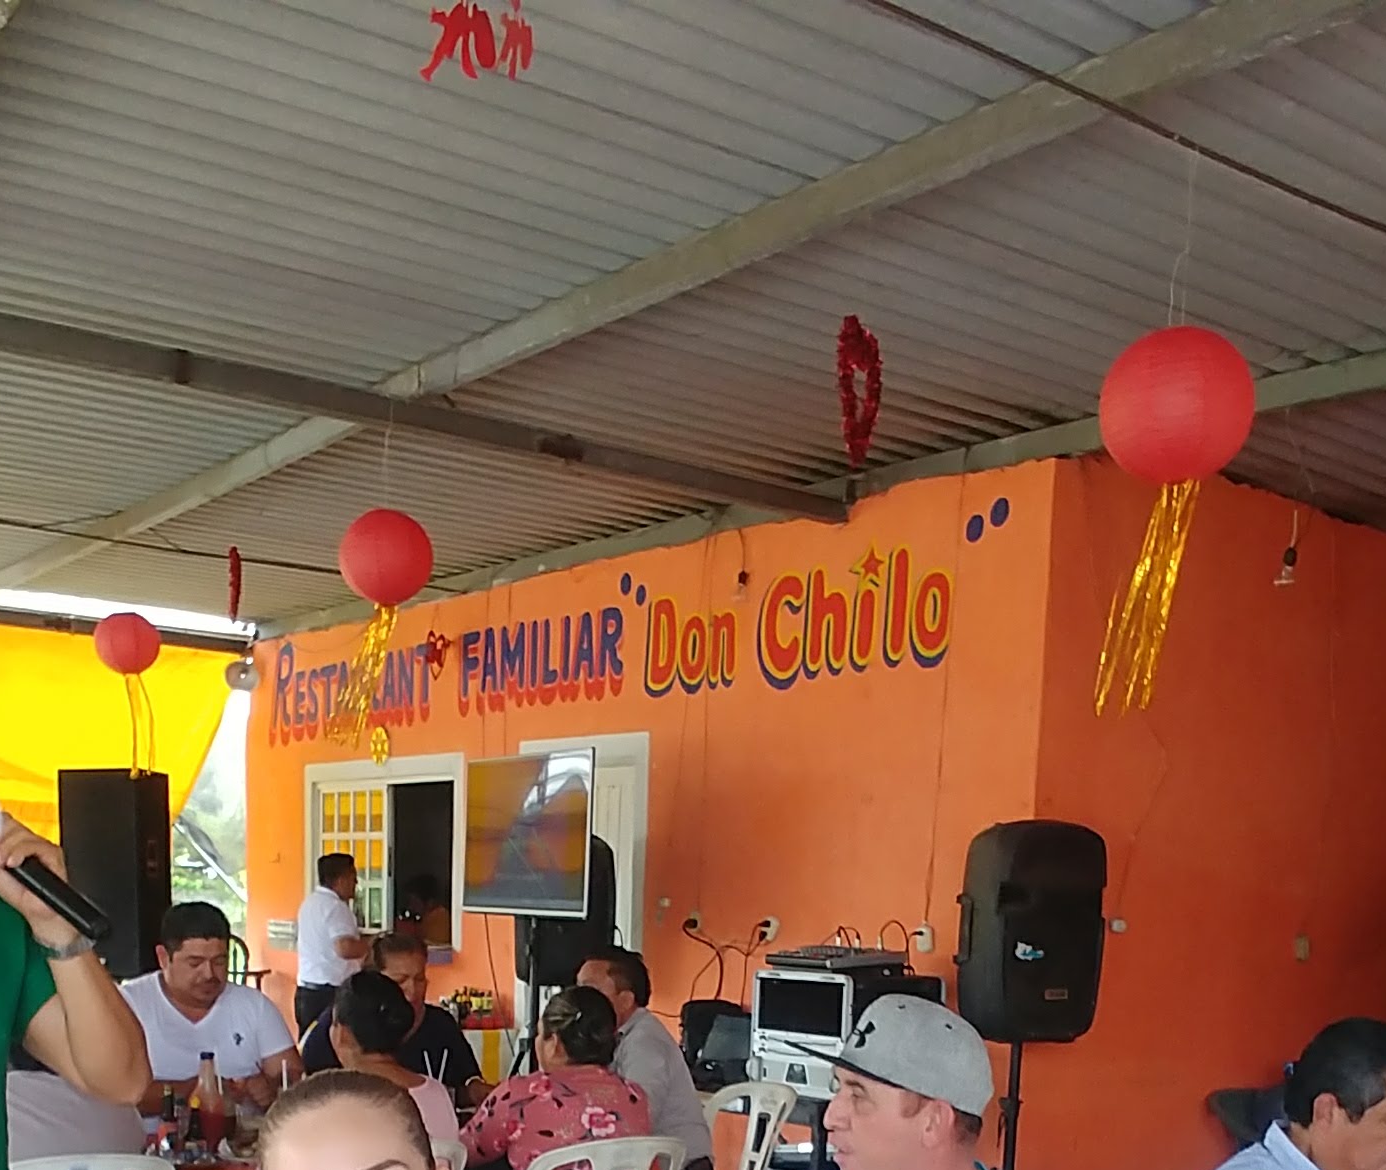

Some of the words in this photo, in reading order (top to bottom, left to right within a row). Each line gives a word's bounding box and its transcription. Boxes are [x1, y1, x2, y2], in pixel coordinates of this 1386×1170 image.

[270, 640, 433, 738] RESTAANT
[459, 605, 625, 708] FAMILIAR
[644, 596, 737, 698] Don
[756, 544, 954, 691] Chilo
